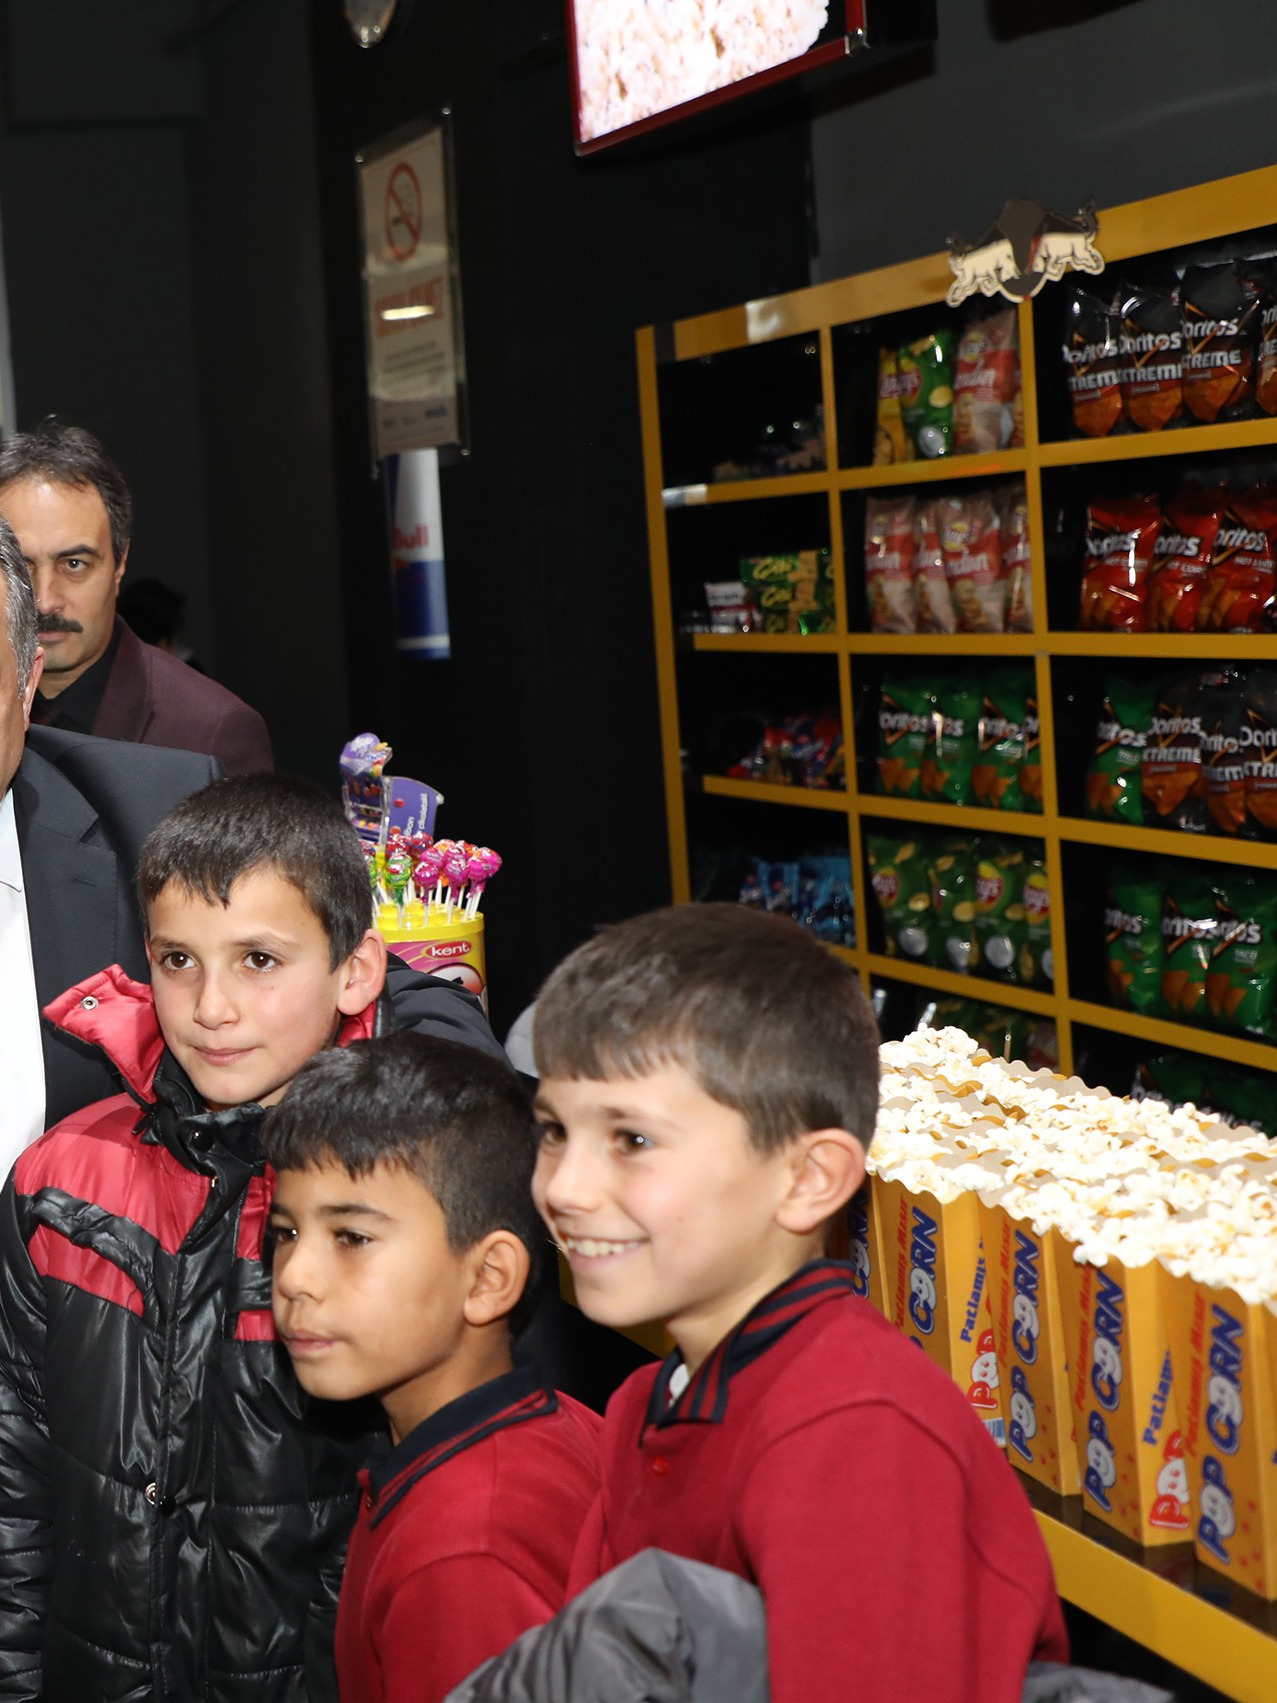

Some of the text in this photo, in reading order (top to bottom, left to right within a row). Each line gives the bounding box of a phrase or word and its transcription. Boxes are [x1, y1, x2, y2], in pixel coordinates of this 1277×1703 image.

[393, 524, 429, 549] Bull
[431, 942, 470, 957] kent
[909, 1206, 938, 1334] CORN
[1009, 1230, 1040, 1463] POP CORN
[1084, 1269, 1125, 1512] POP CORN
[1198, 1303, 1244, 1564] POP CORN
